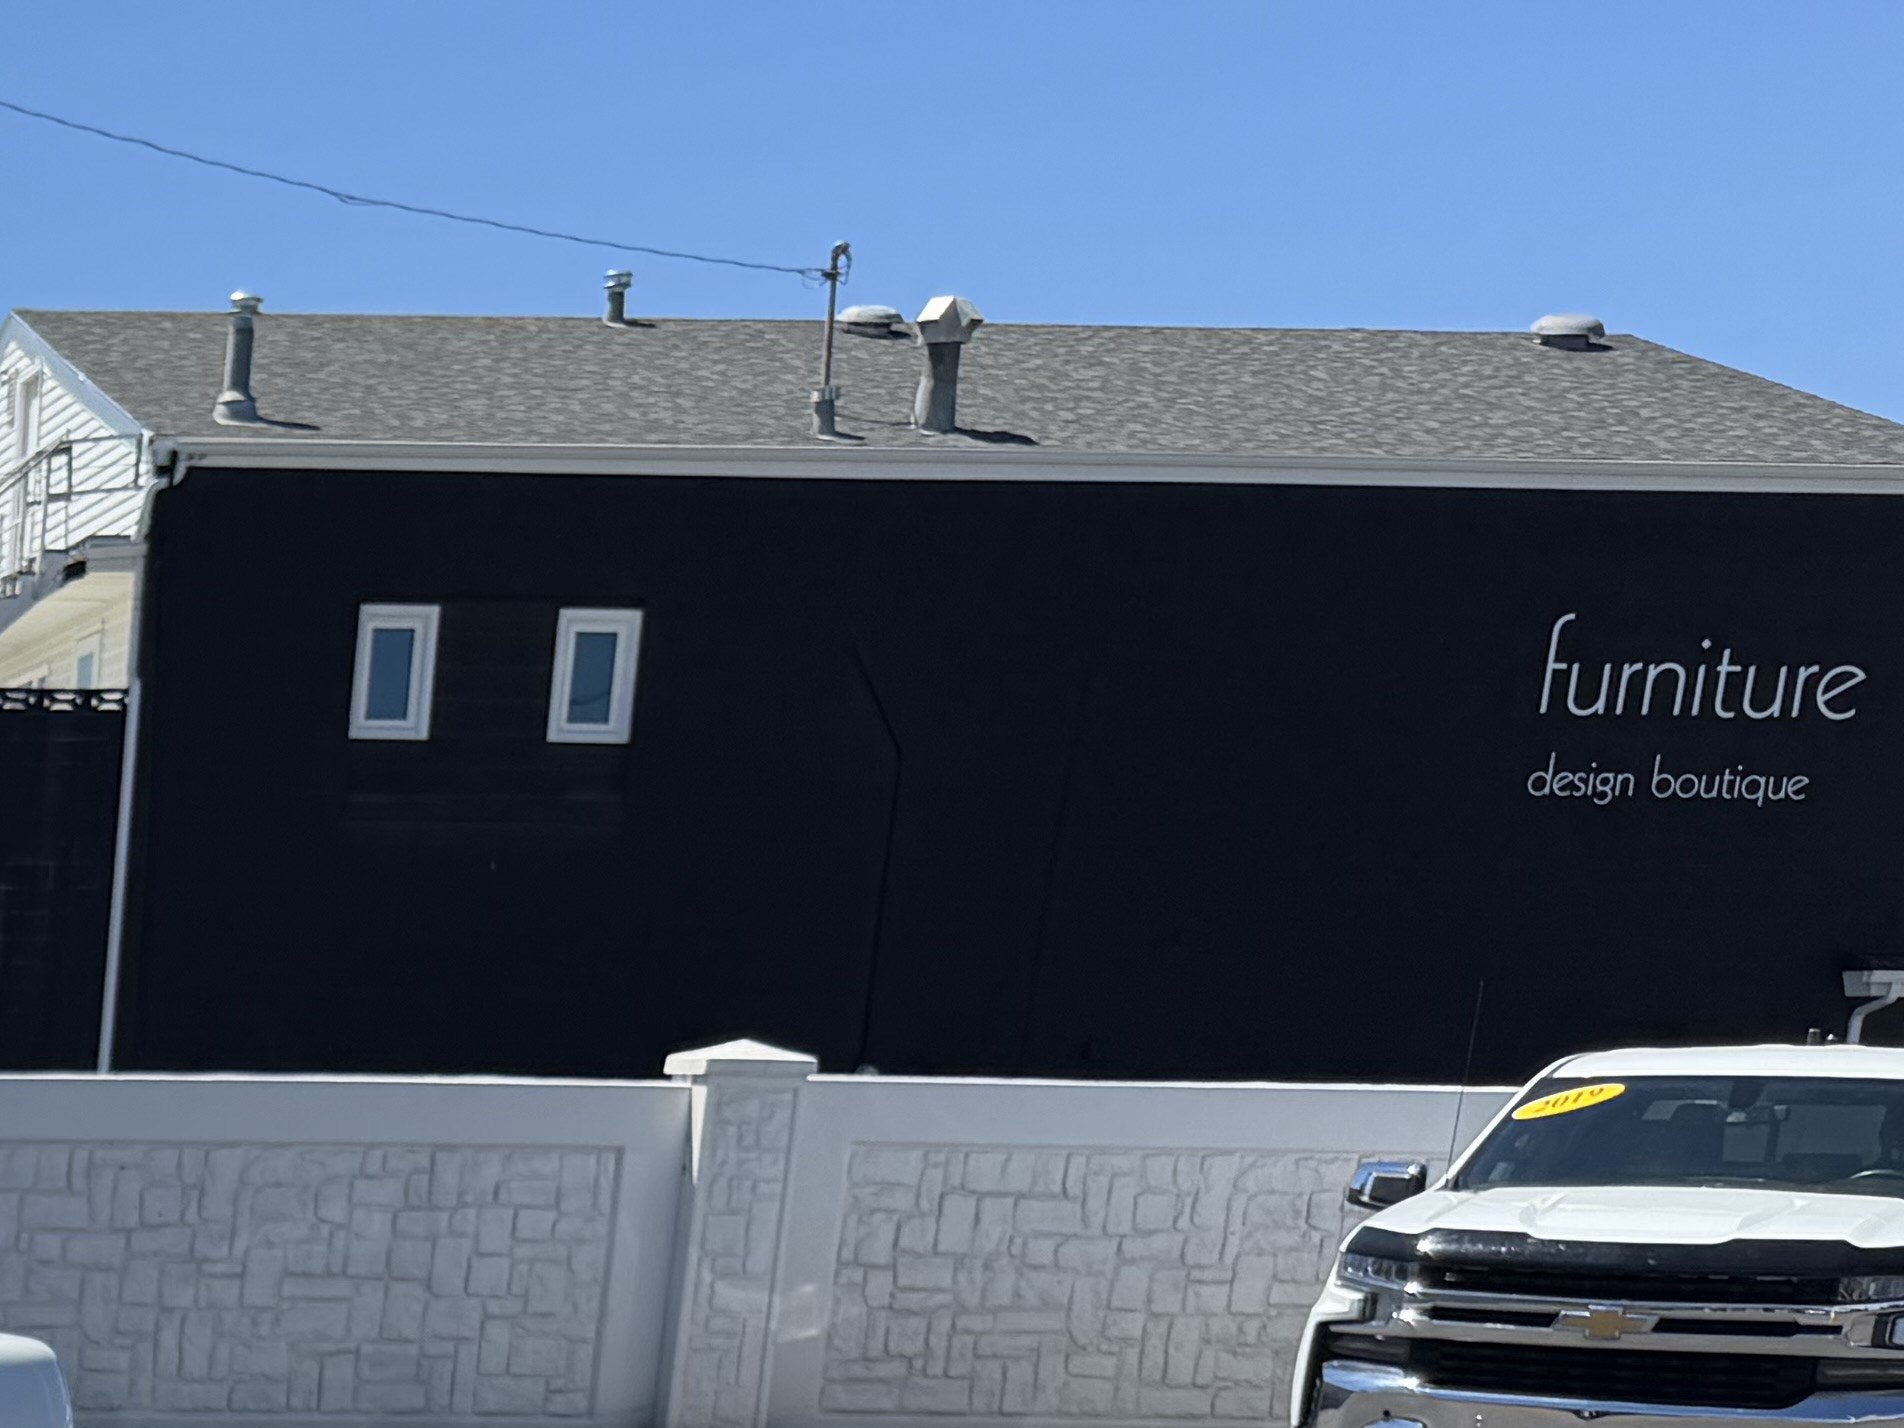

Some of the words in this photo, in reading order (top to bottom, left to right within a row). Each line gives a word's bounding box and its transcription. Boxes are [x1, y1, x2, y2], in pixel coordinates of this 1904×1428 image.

[1539, 613, 1867, 721] furniture
[1527, 751, 1635, 805] design
[1651, 754, 1810, 807] boutique
